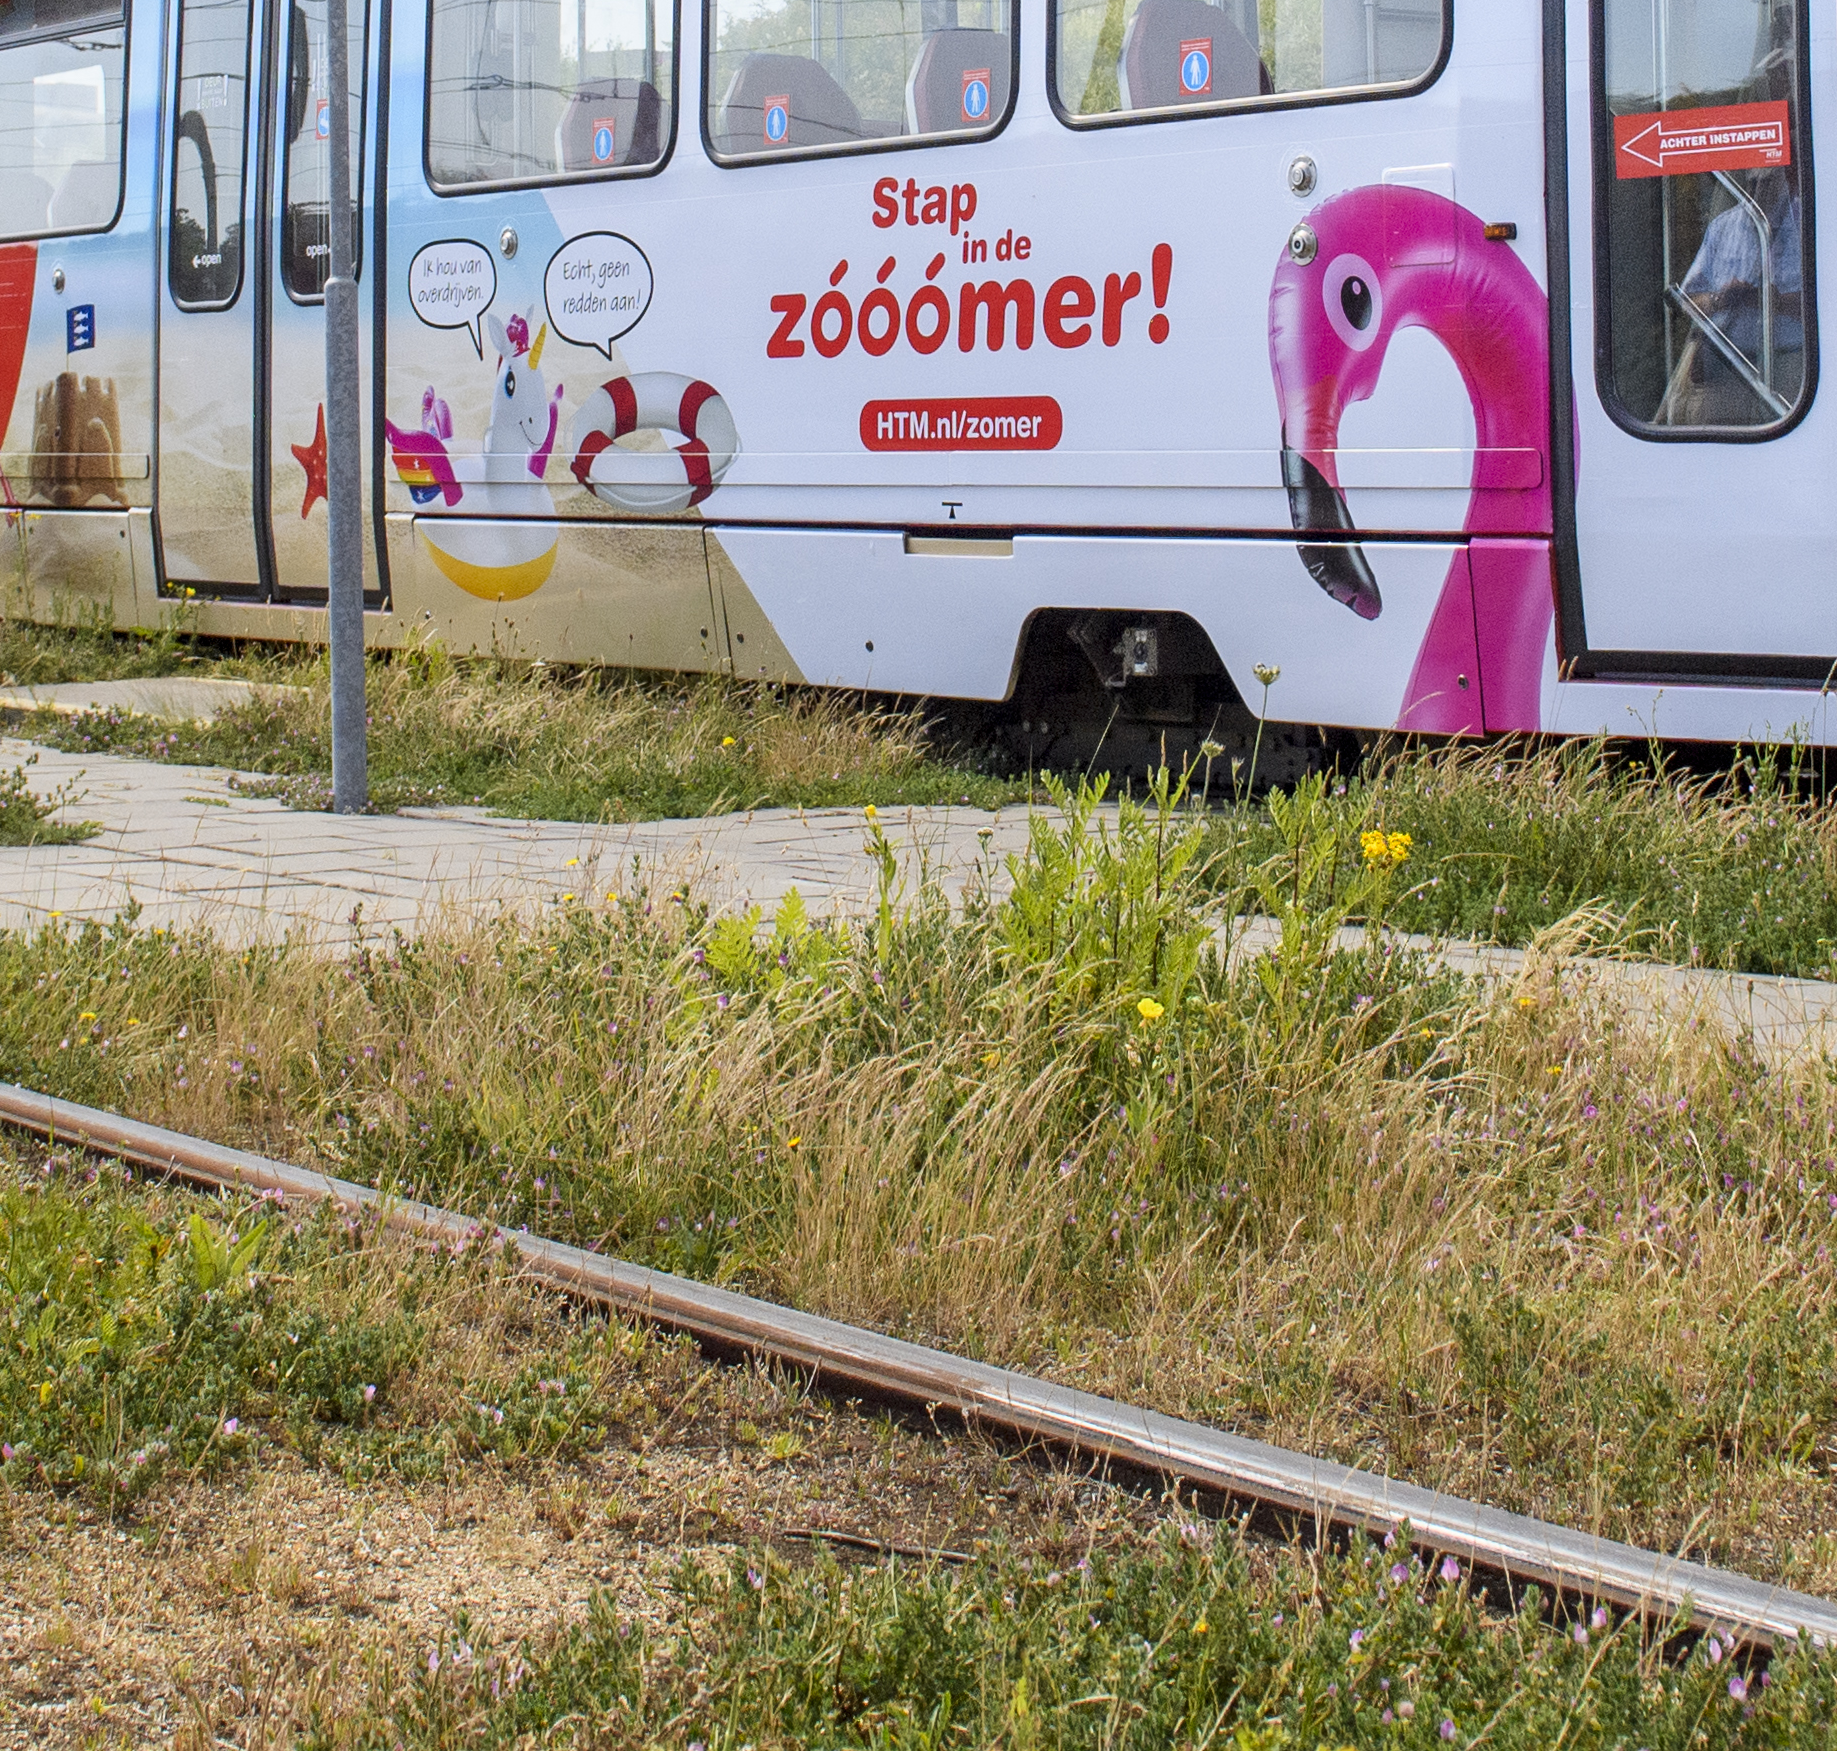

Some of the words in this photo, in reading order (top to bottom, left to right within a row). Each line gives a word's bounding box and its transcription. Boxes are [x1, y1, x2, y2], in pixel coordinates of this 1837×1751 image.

[1659, 134, 1708, 150] ACHTER
[1708, 128, 1777, 146] INSTAPPEN
[871, 176, 978, 236] Stap
[306, 243, 329, 259] open
[961, 230, 987, 265] in
[995, 228, 1032, 262] de
[200, 252, 223, 269] open
[423, 258, 434, 278] Ik
[436, 256, 458, 276] hou
[459, 259, 482, 275] van
[562, 259, 597, 285] Echt,
[596, 260, 631, 289] geen
[417, 281, 485, 308] overdrijven.
[562, 291, 607, 315] redden
[610, 288, 642, 312] aan!
[765, 242, 1174, 359] zóóómer!
[876, 409, 1043, 440] HTM.nl/zomer
